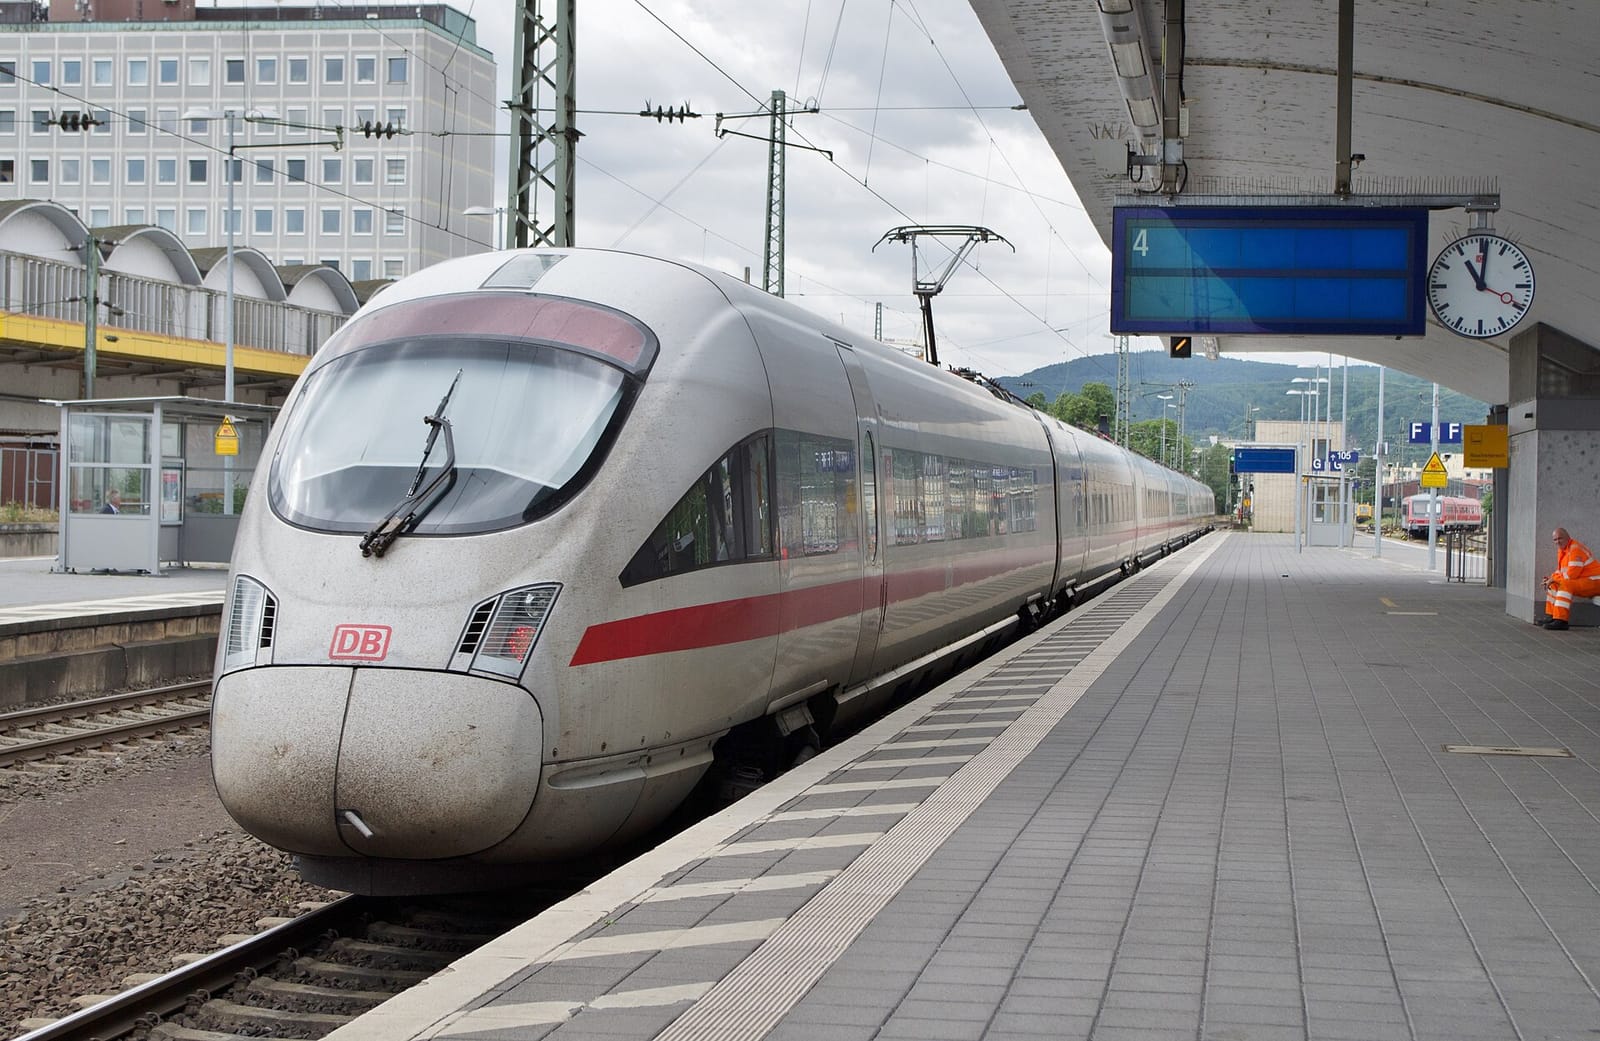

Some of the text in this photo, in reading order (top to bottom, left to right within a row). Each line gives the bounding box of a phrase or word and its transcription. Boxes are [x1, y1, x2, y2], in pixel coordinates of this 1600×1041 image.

[1133, 229, 1149, 257] 4
[1411, 423, 1423, 440] F
[1449, 423, 1460, 440] F
[1313, 458, 1322, 470] G
[1337, 451, 1352, 460] 105
[335, 629, 384, 656] DB
